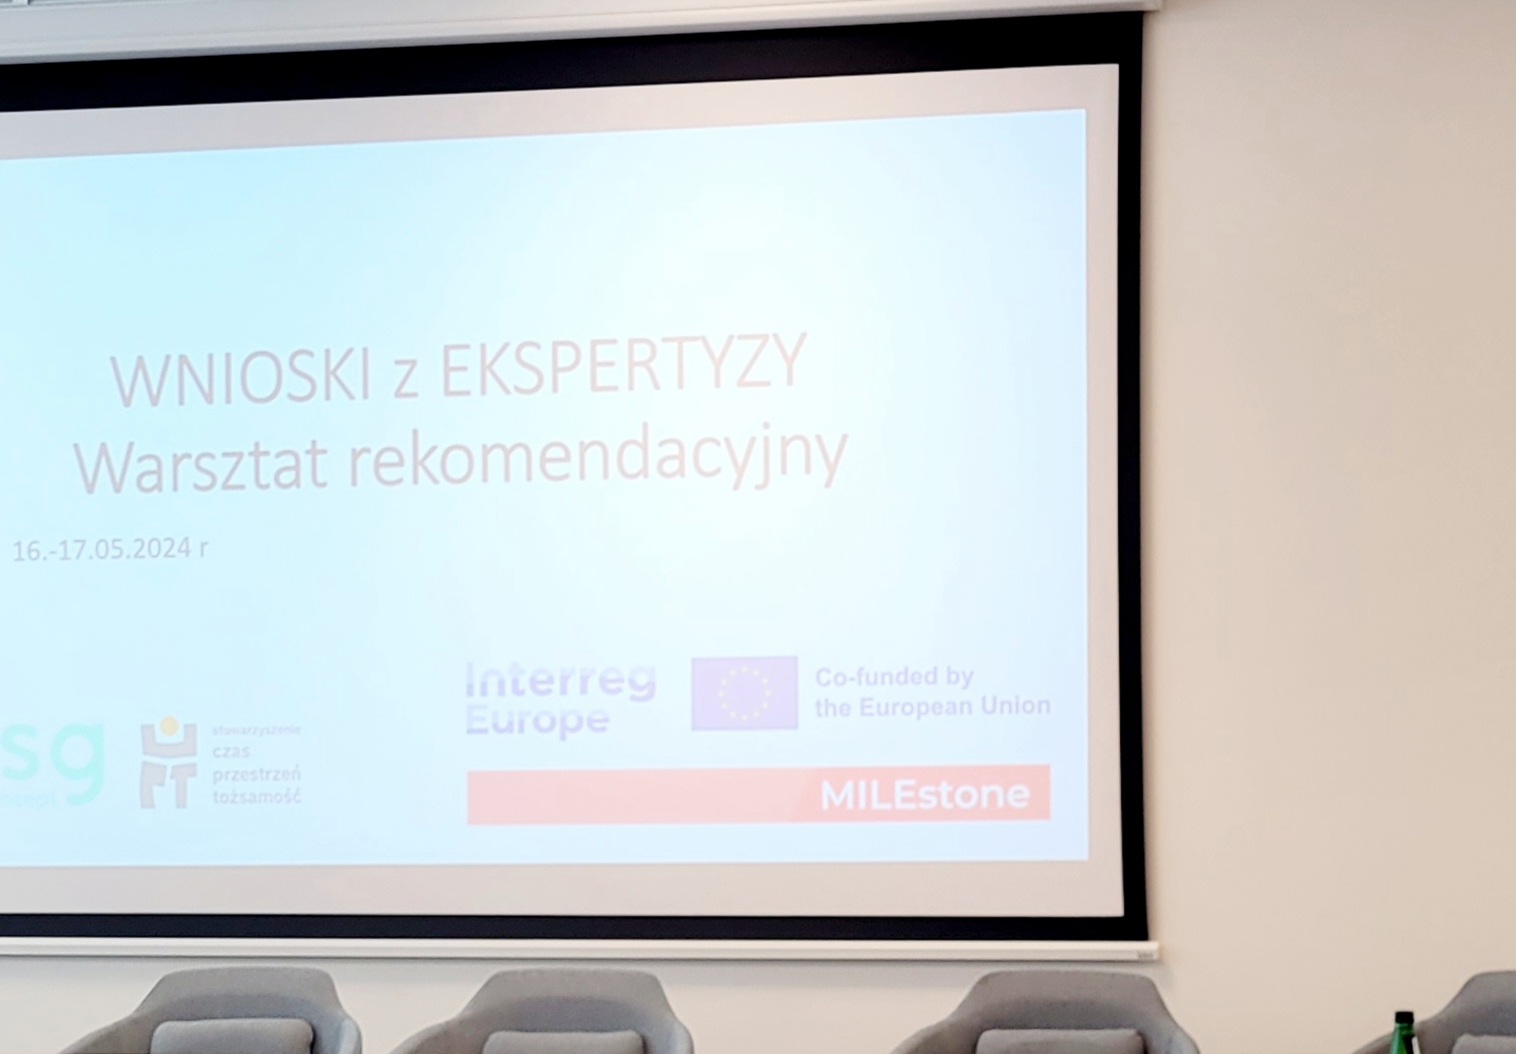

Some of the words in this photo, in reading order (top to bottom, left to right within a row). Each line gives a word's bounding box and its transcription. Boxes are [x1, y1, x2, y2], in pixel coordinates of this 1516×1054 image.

[110, 347, 371, 409] WNIOSKI
[392, 355, 420, 399] z
[441, 332, 808, 397] EKSPERTYZY
[72, 437, 329, 496] Warsztat
[349, 420, 850, 493] rekomendacyjny
[12, 537, 192, 563] 16.-17.05.2024
[465, 660, 657, 703] Interreg
[815, 666, 940, 688] Co-funded
[946, 666, 975, 690] by
[815, 697, 852, 718] the
[860, 695, 973, 721] European
[980, 694, 1052, 716] Union
[465, 703, 610, 742] Europe
[212, 744, 251, 759] czas
[212, 764, 302, 785] przestrzeń
[212, 787, 303, 805] tożsamość
[820, 778, 1031, 812] MILEstone
